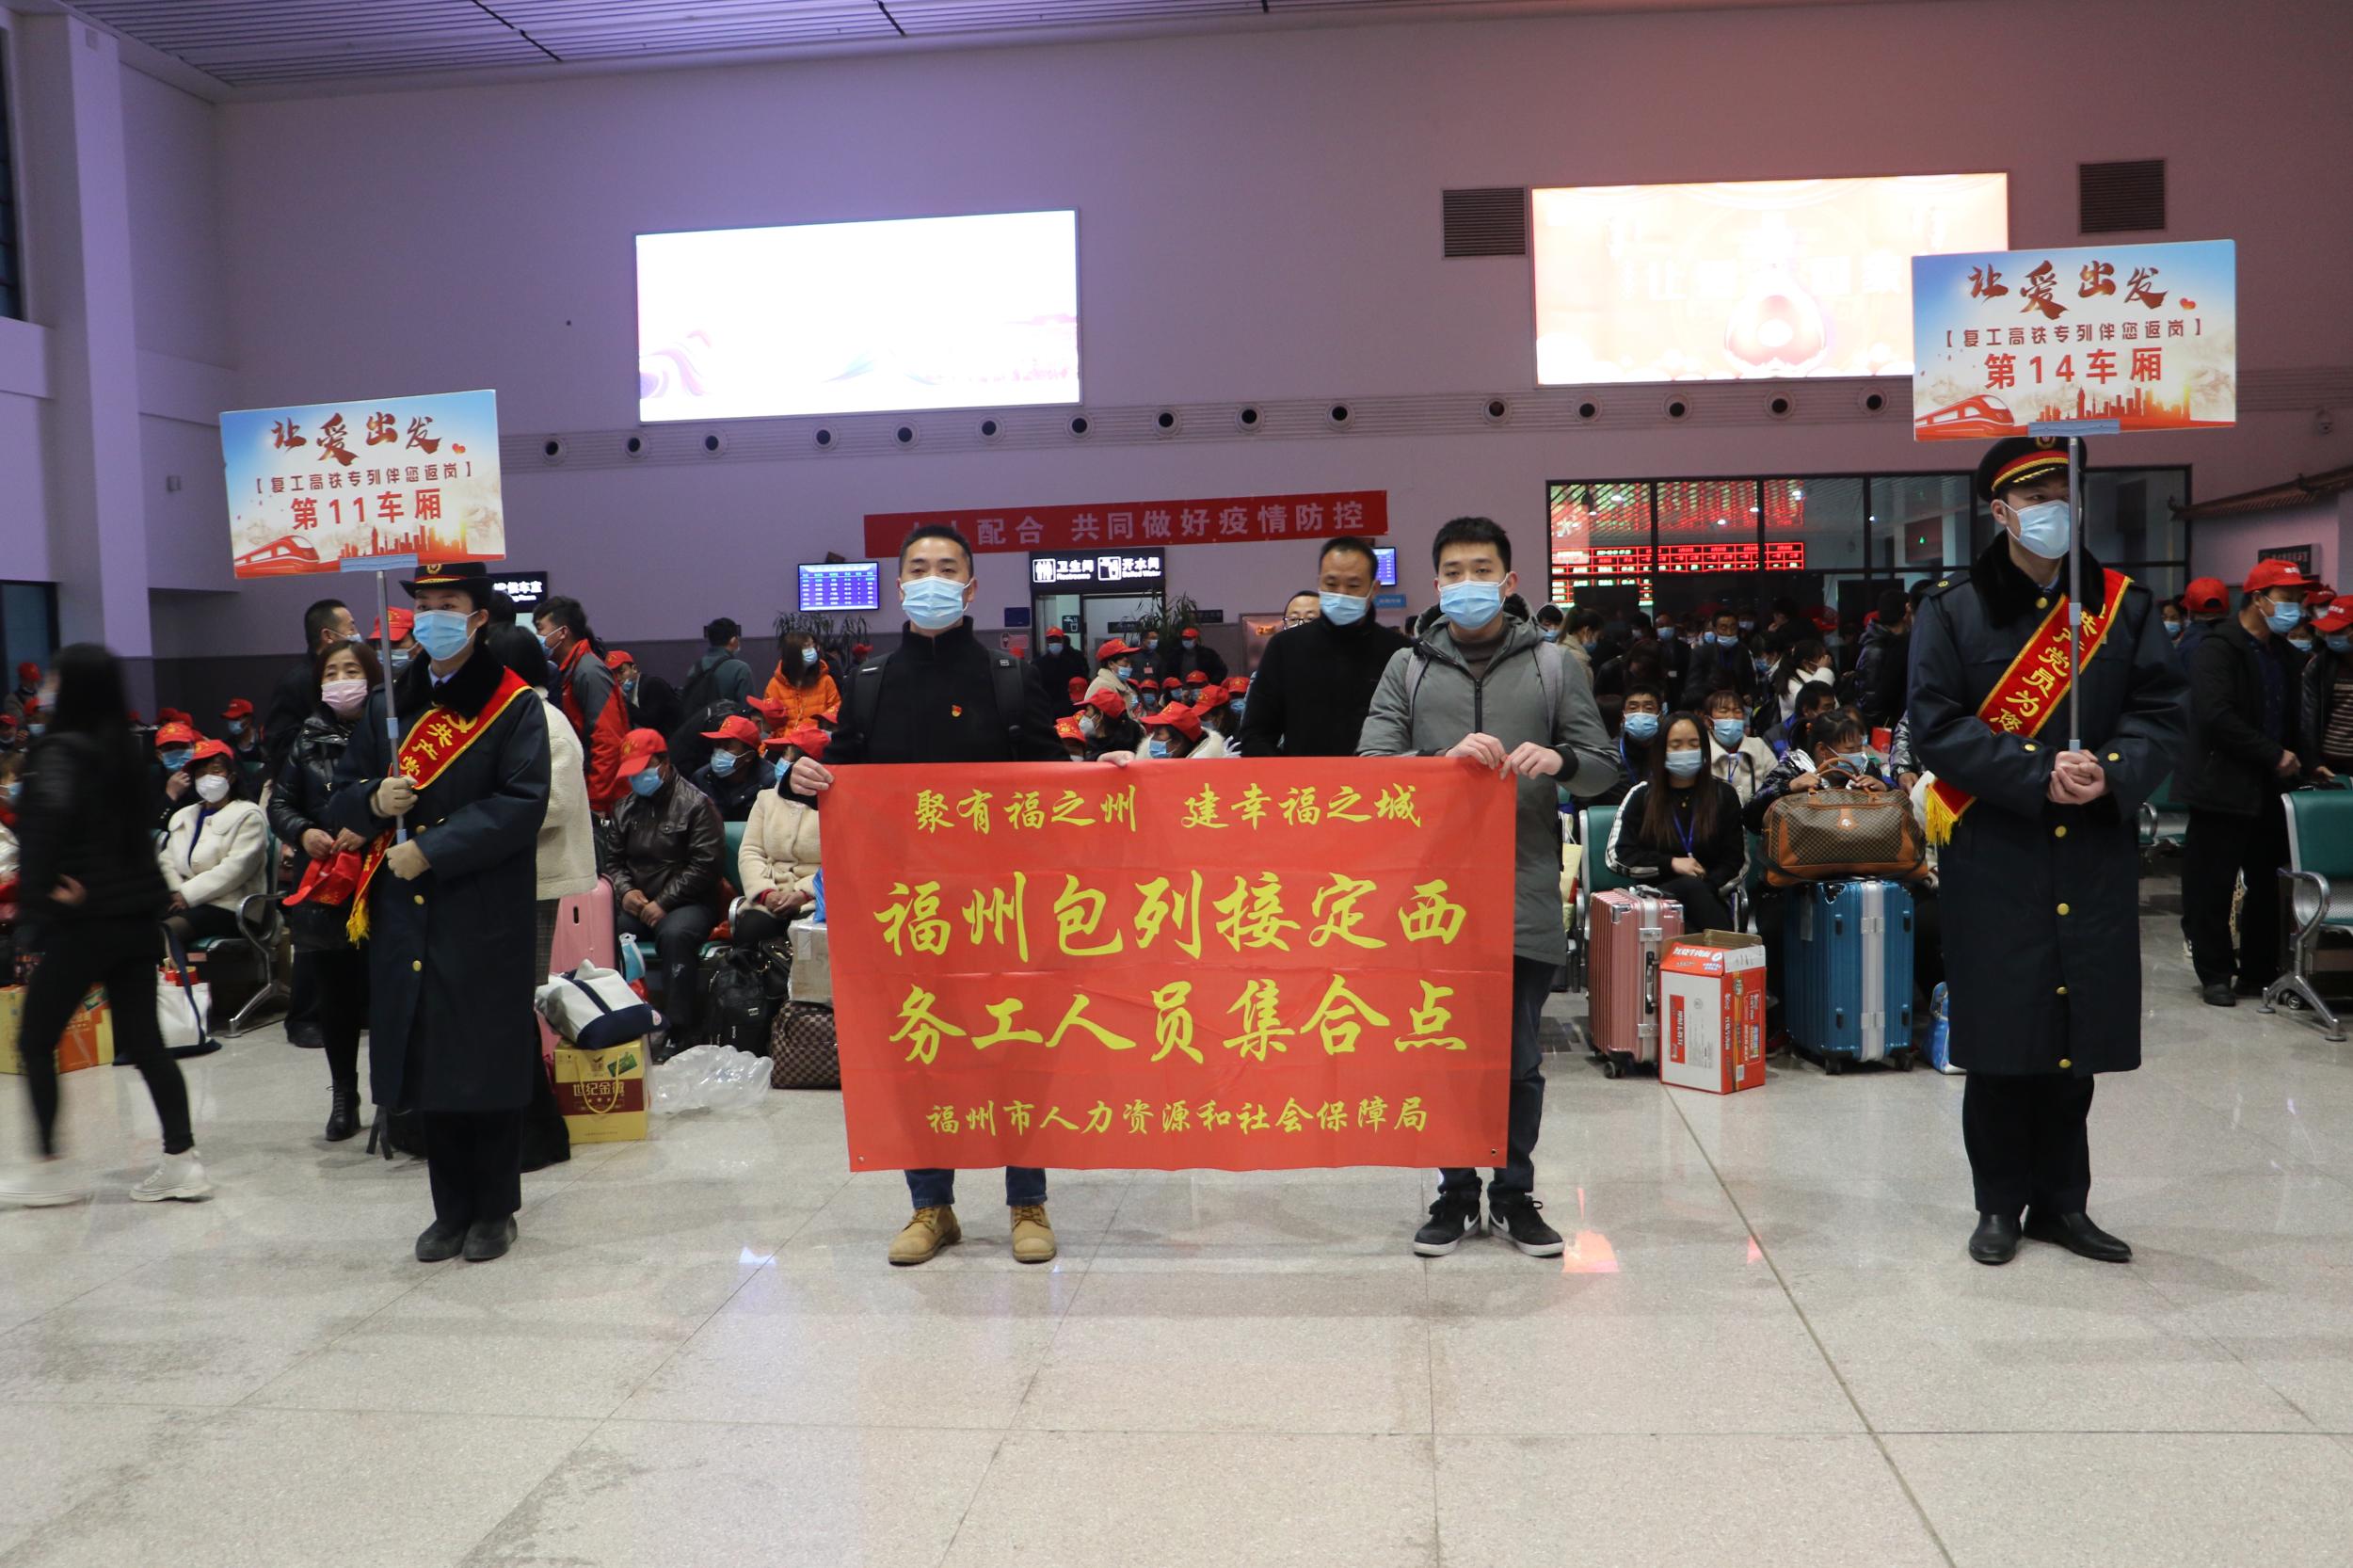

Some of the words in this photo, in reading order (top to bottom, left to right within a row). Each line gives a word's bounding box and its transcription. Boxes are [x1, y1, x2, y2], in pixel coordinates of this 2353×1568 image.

[1967, 259, 2169, 321] 让爱出发
[1984, 347, 2162, 390] 第14车厢
[271, 412, 441, 467] 让爱出发
[291, 488, 441, 531] 第11车厢
[1071, 501, 1364, 541] 共同做好疫情防控
[916, 785, 1137, 835] 聚有福之州
[1181, 782, 1423, 830] 建幸福之城
[874, 870, 1467, 964] 福州包列接定西
[888, 974, 1468, 1065] 务工人员集合点
[926, 1096, 1429, 1136] 福州市人力资源和社会保障局
